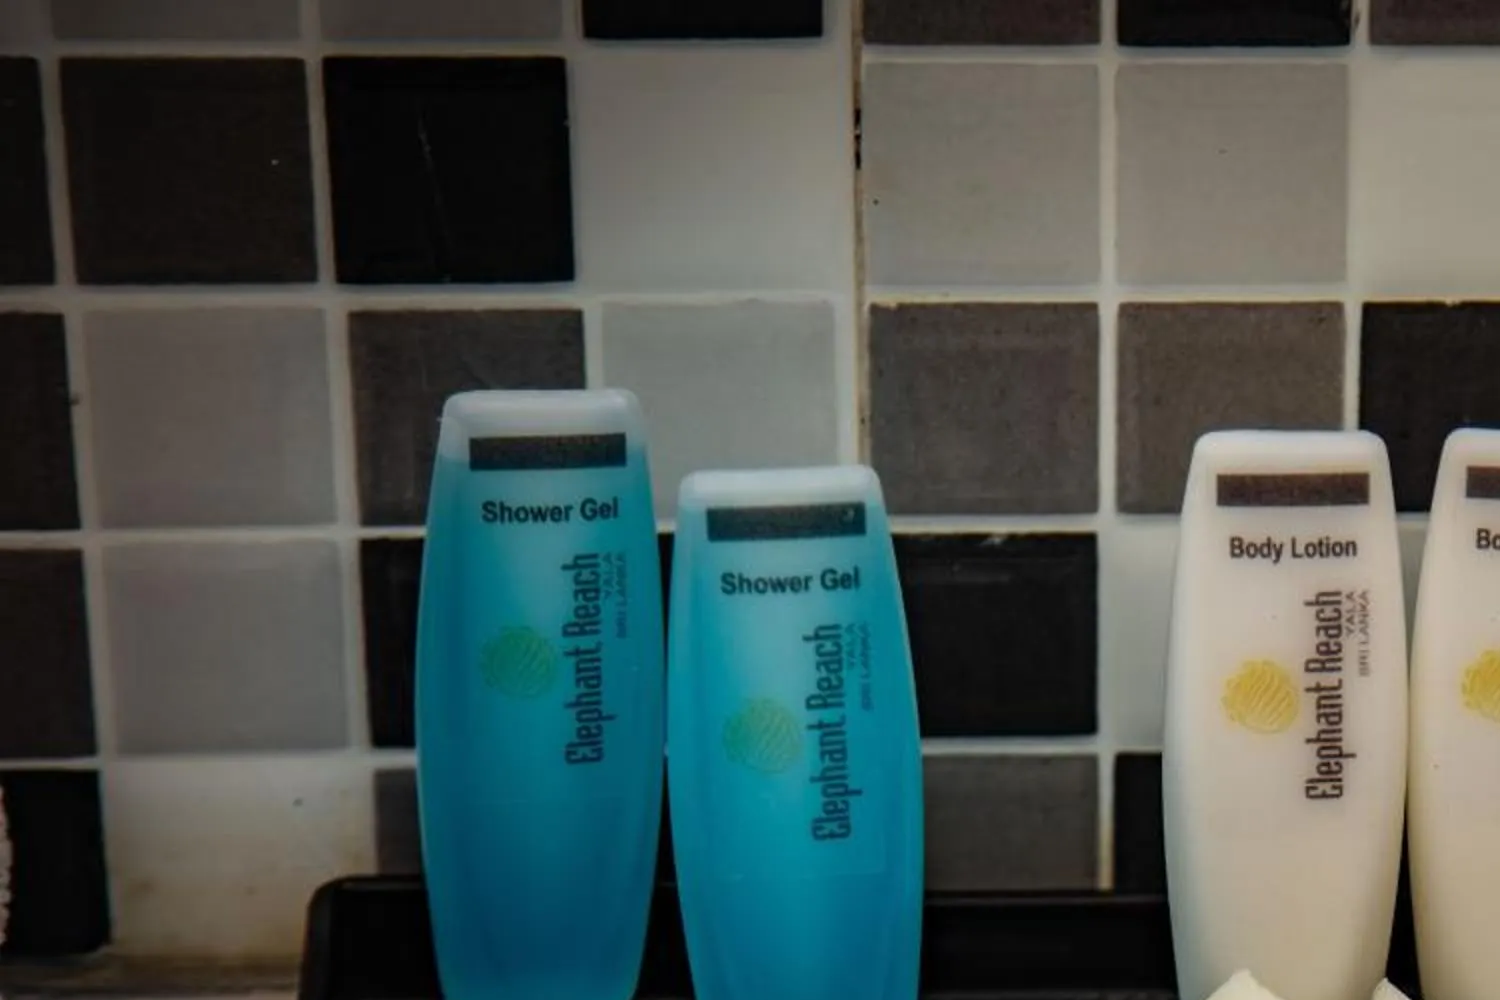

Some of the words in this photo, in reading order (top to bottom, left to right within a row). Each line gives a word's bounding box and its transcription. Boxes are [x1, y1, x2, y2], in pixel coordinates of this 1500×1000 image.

[480, 499, 574, 526] Shower
[579, 496, 619, 521] Gel
[1229, 535, 1284, 564] Body
[1291, 536, 1357, 559] Lotion
[561, 552, 602, 639] Reach
[719, 570, 814, 596] Shower
[819, 566, 861, 593] Gel
[1345, 590, 1356, 638] YALA
[1358, 589, 1370, 646] LANKA
[802, 622, 846, 712] Reach
[1303, 590, 1343, 674] Reach
[564, 640, 618, 765] Elephant
[1304, 678, 1357, 800] Elephant
[811, 713, 863, 841] Elephant
